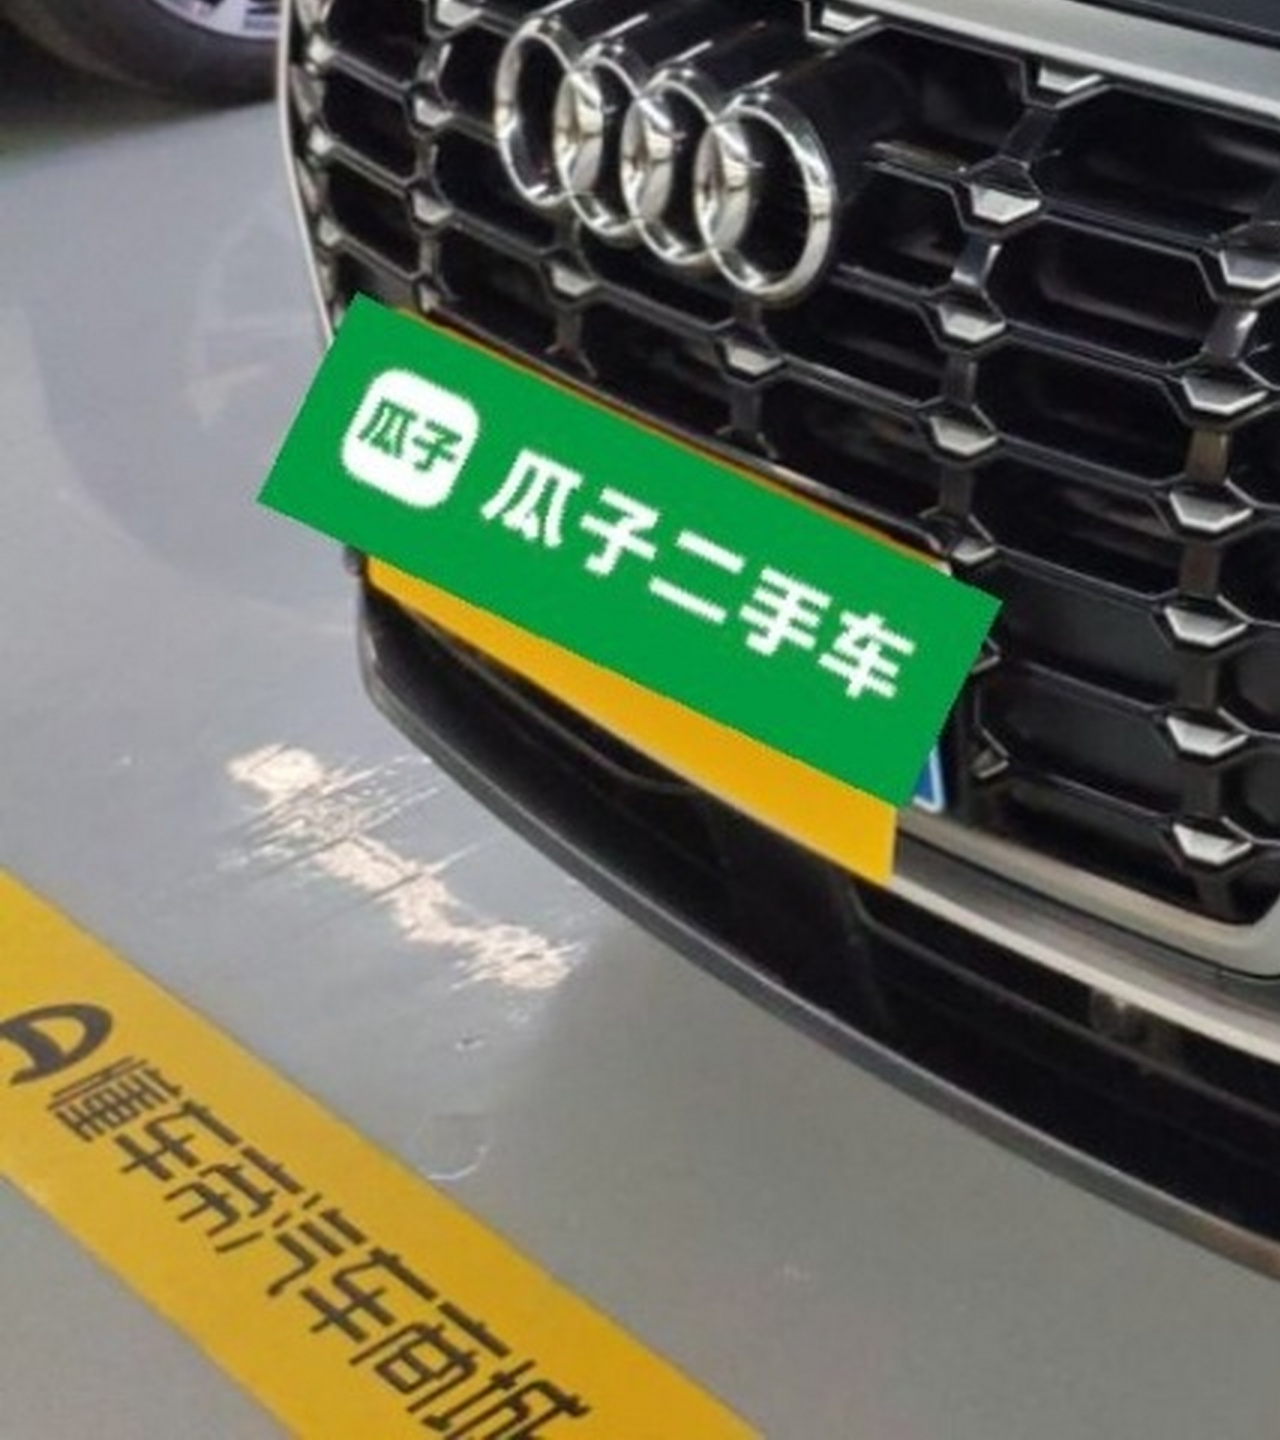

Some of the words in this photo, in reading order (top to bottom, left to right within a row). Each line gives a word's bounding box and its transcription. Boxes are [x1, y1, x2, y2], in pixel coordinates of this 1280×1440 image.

[47, 1057, 592, 1440] 懂车帝汽车商城
